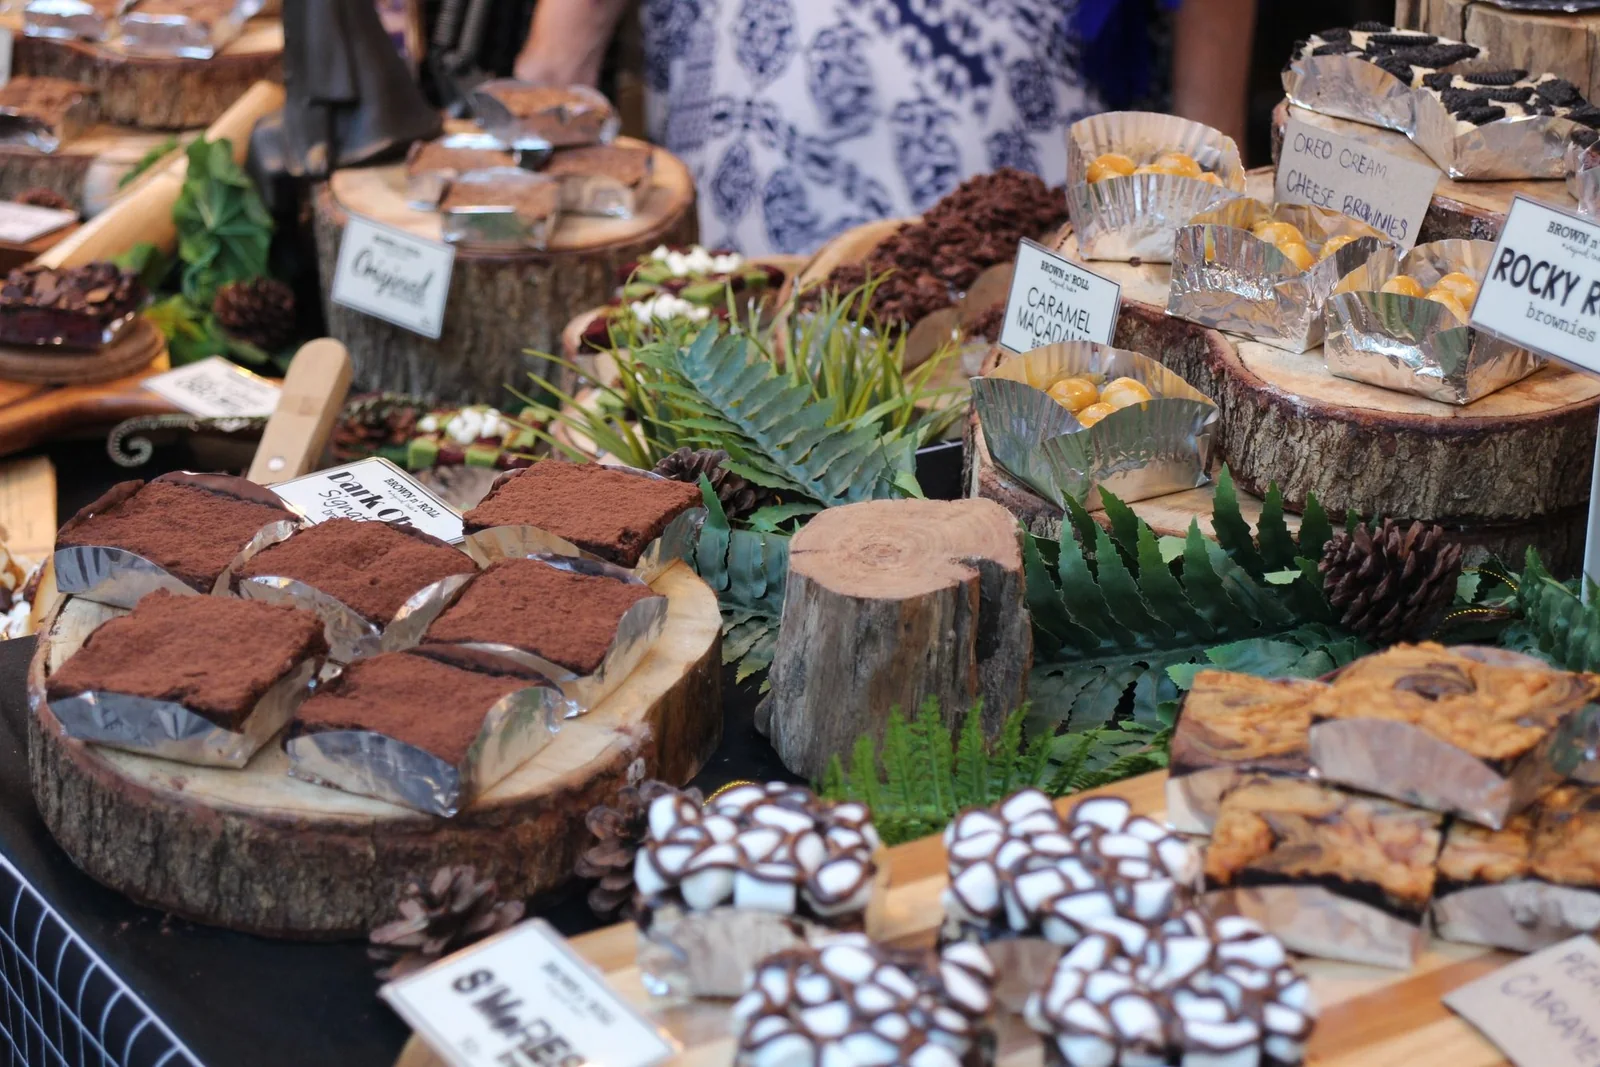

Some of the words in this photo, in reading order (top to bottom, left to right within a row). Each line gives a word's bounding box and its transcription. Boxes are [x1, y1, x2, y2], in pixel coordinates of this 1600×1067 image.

[1293, 132, 1332, 159] OREO
[1339, 148, 1387, 180] CREAM
[1286, 169, 1335, 209] CHEESE
[1342, 195, 1408, 240] BROWNIES
[1546, 221, 1591, 246] BROWN
[1040, 260, 1065, 279] BROWN
[1072, 274, 1090, 291] ROLL
[1492, 246, 1581, 307] ROCKY
[1016, 305, 1090, 343] MACADA
[1027, 286, 1091, 334] CARAMEL
[1525, 302, 1596, 343] brownies
[318, 489, 373, 521] Signat
[327, 471, 385, 510] Dark
[384, 478, 416, 499] BROWN
[417, 502, 441, 519] ROLL
